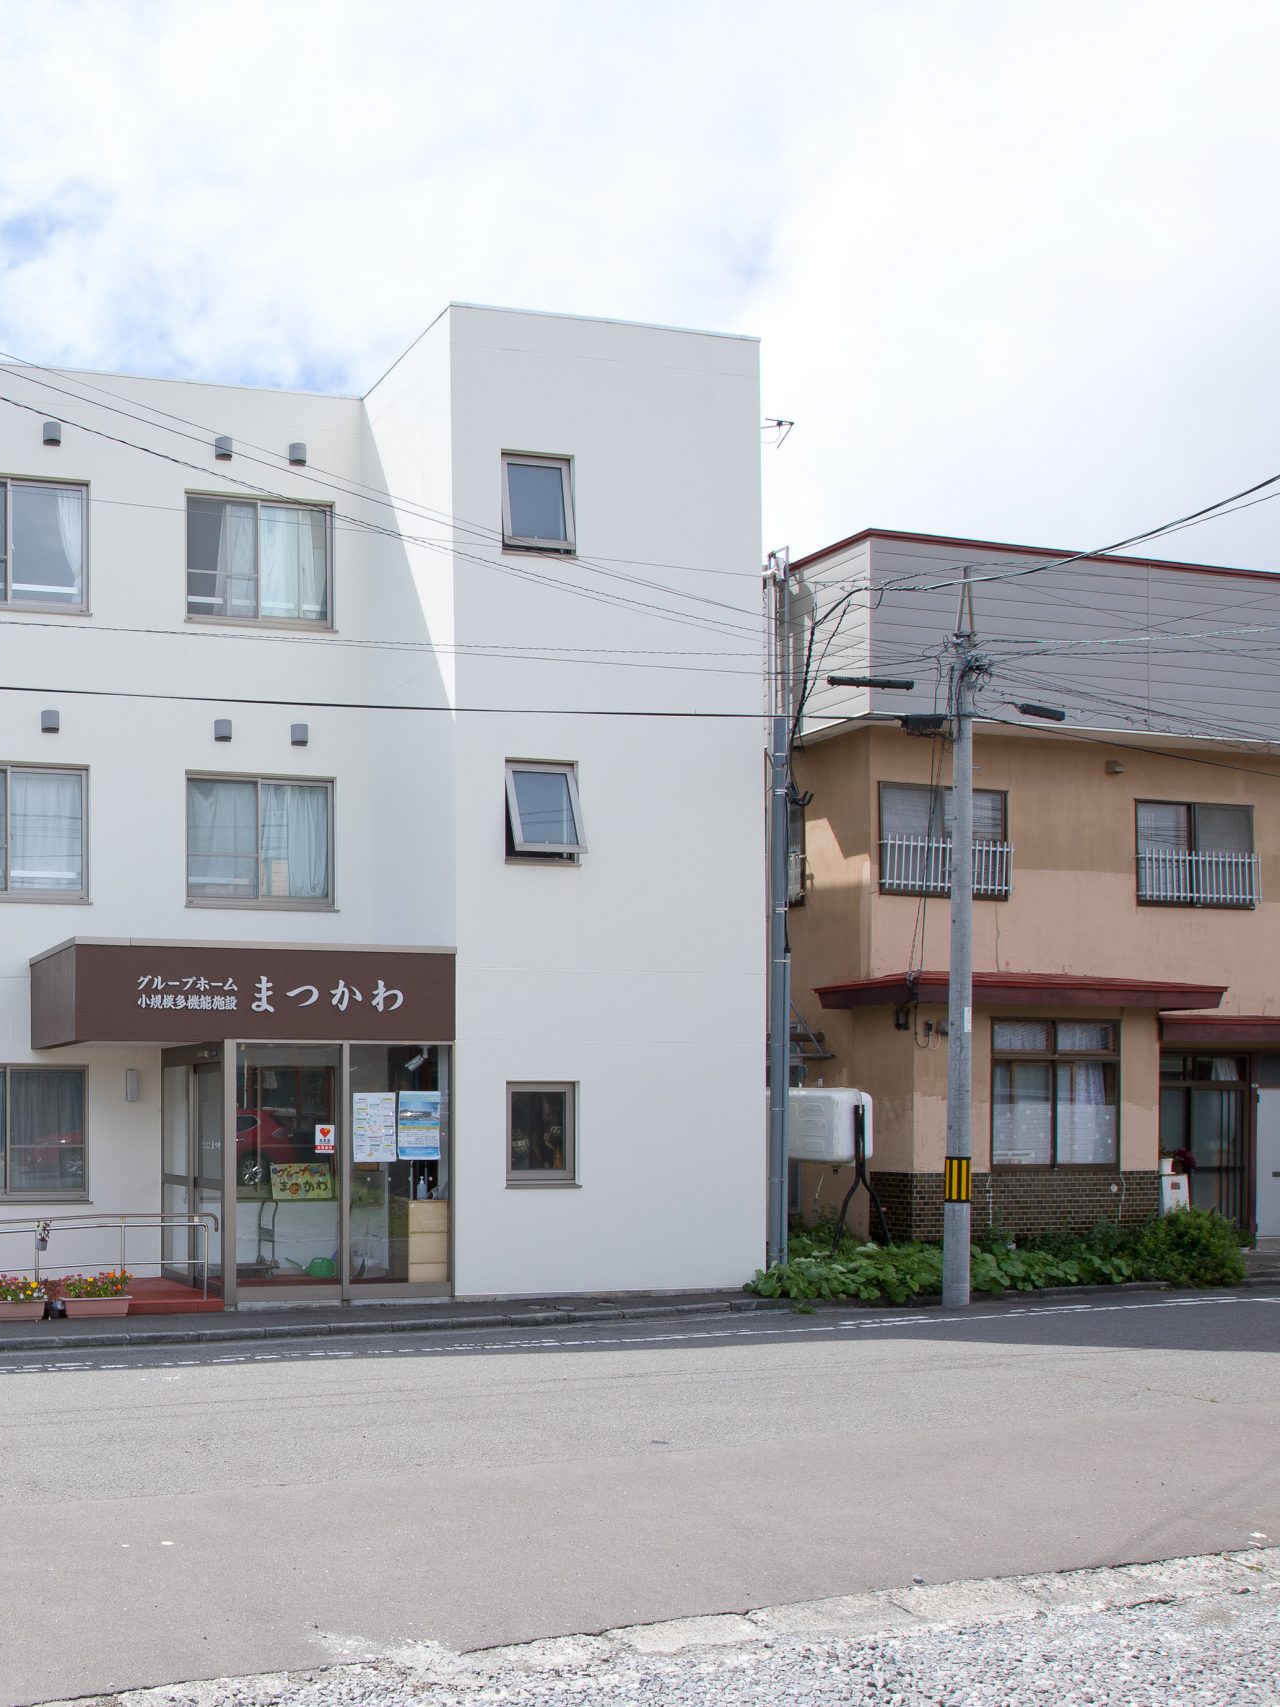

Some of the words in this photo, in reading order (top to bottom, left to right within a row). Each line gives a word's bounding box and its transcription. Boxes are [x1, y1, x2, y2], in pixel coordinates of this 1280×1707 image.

[137, 974, 238, 991] グループホーム
[137, 993, 238, 1010] 小規模多機能施設
[251, 975, 404, 1013] まつかわ
